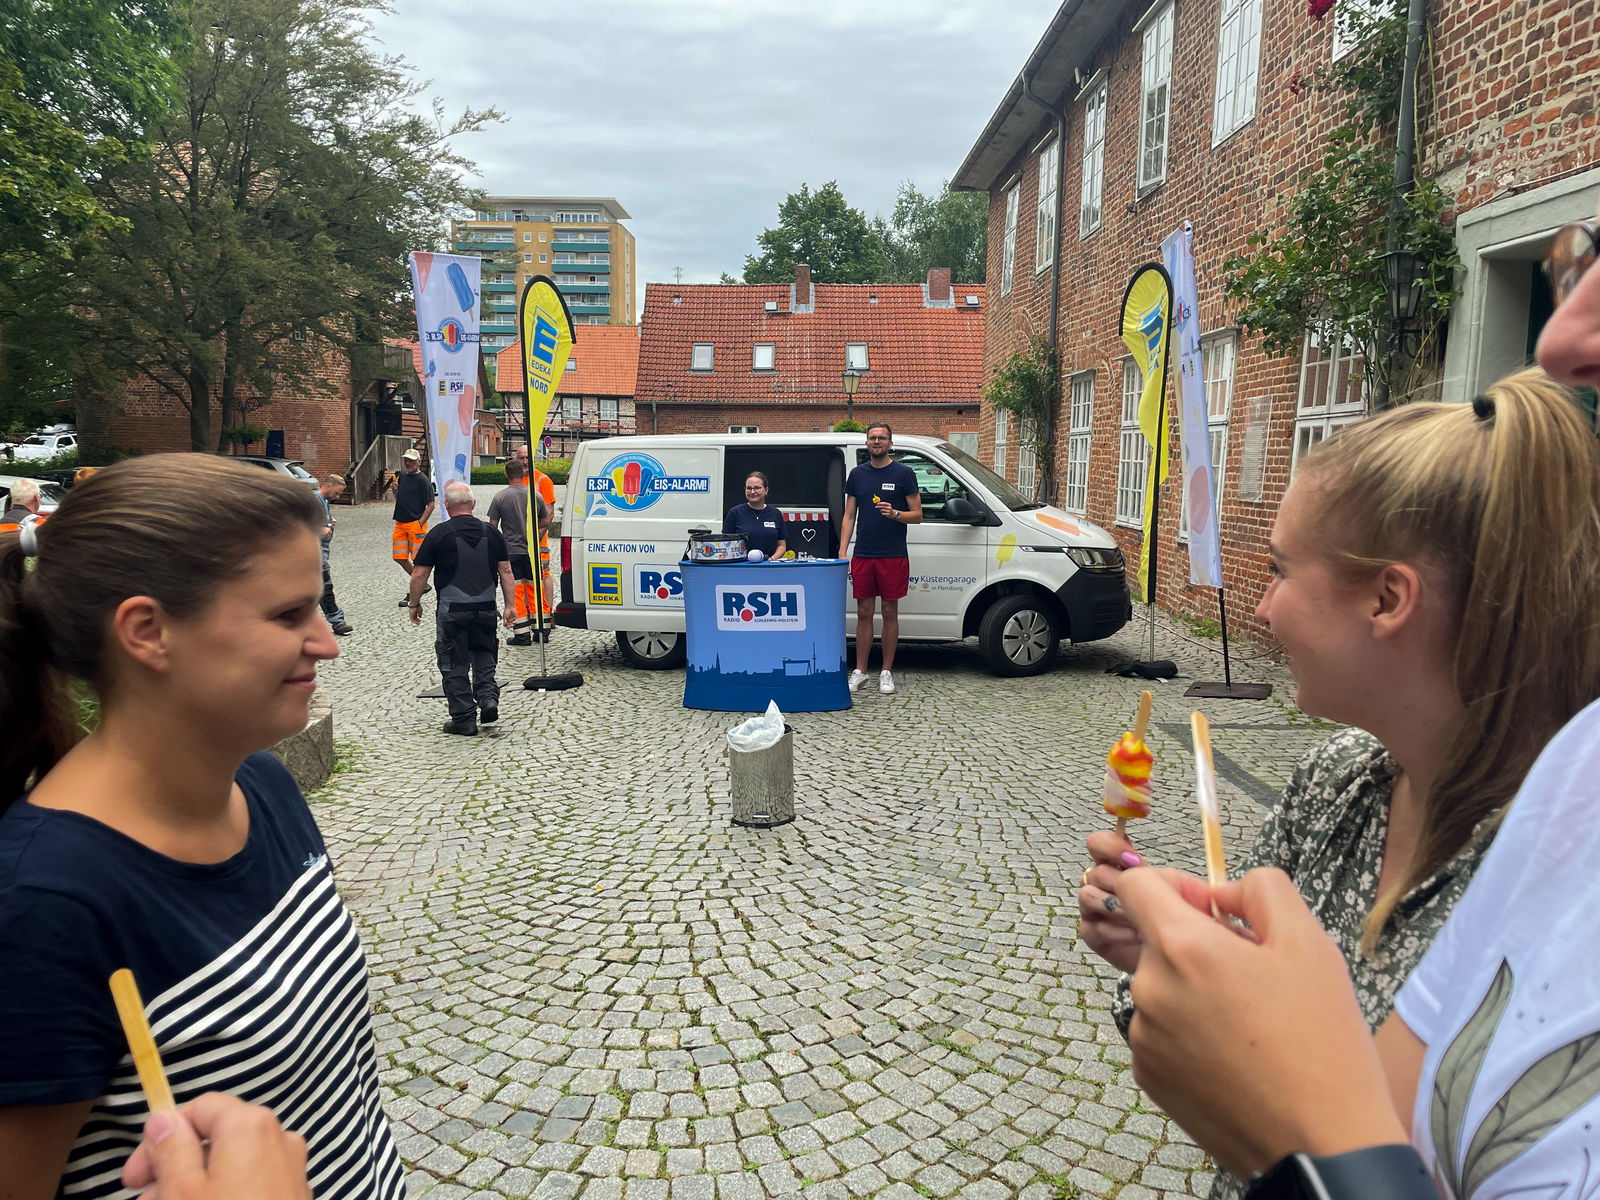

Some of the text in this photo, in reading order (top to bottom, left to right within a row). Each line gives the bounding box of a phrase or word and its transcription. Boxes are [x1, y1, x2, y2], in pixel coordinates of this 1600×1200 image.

[531, 360, 551, 376] EDEKA
[530, 376, 549, 394] NORD
[588, 479, 707, 490] R.SH EIS-ALARM!
[588, 543, 655, 553] EINE AKTION VON
[920, 576, 977, 584] Küstengarage
